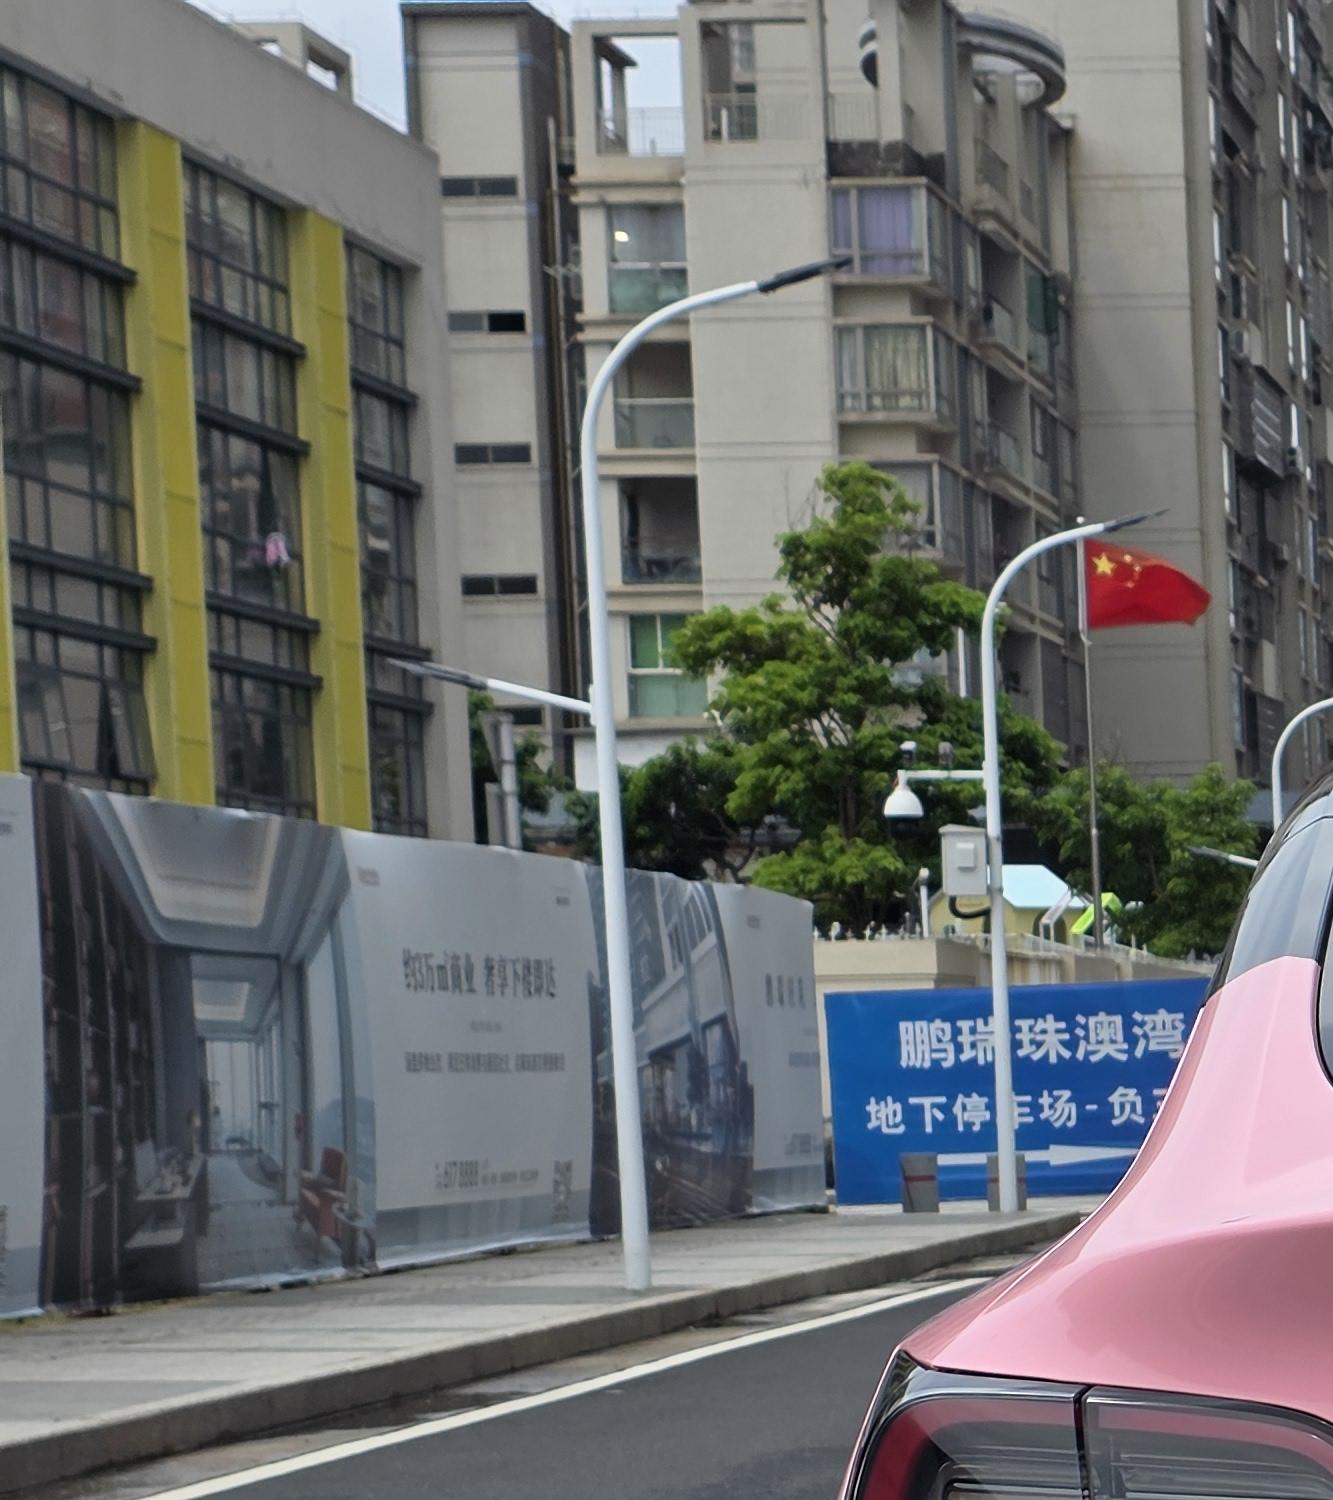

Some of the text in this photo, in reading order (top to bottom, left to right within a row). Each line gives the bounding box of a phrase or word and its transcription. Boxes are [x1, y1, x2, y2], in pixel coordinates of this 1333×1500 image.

[899, 1008, 1186, 1070] 鹏瑞珠澳湾
